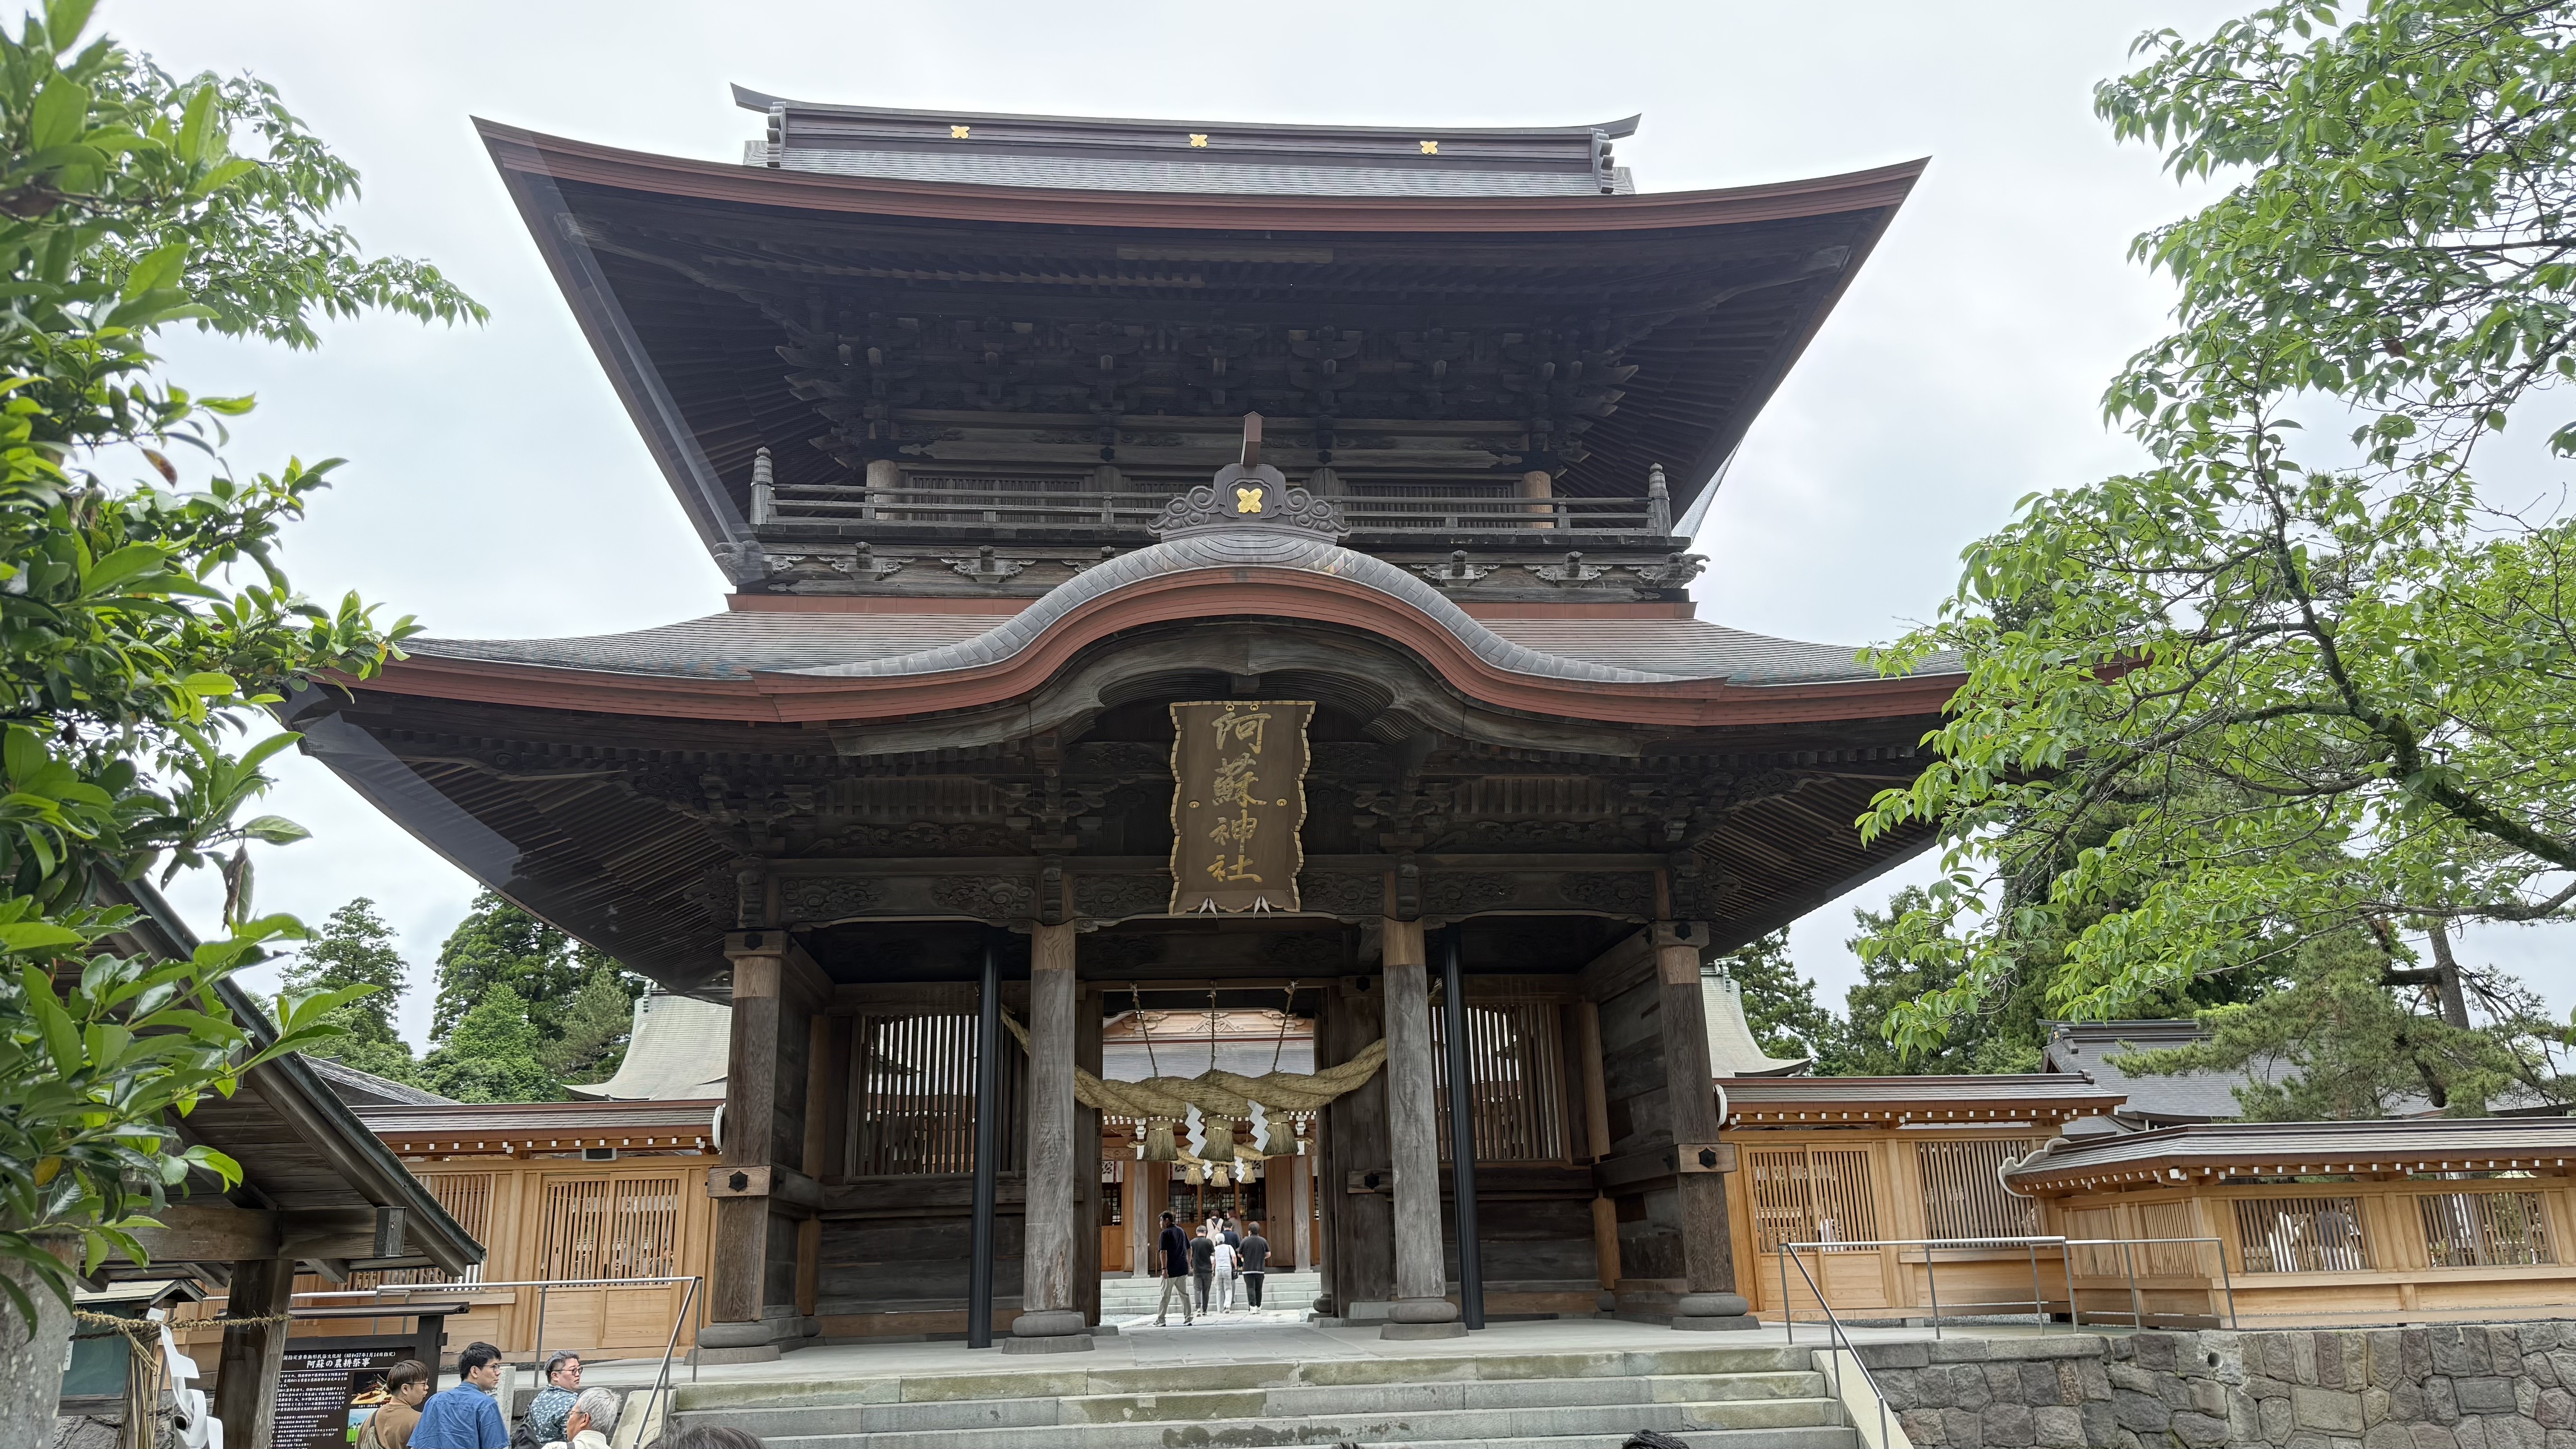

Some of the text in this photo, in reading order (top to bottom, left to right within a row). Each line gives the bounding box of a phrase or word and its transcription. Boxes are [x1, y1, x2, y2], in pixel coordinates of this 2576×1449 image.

[307, 1357, 371, 1369] 阿蘇の農耕祭事
